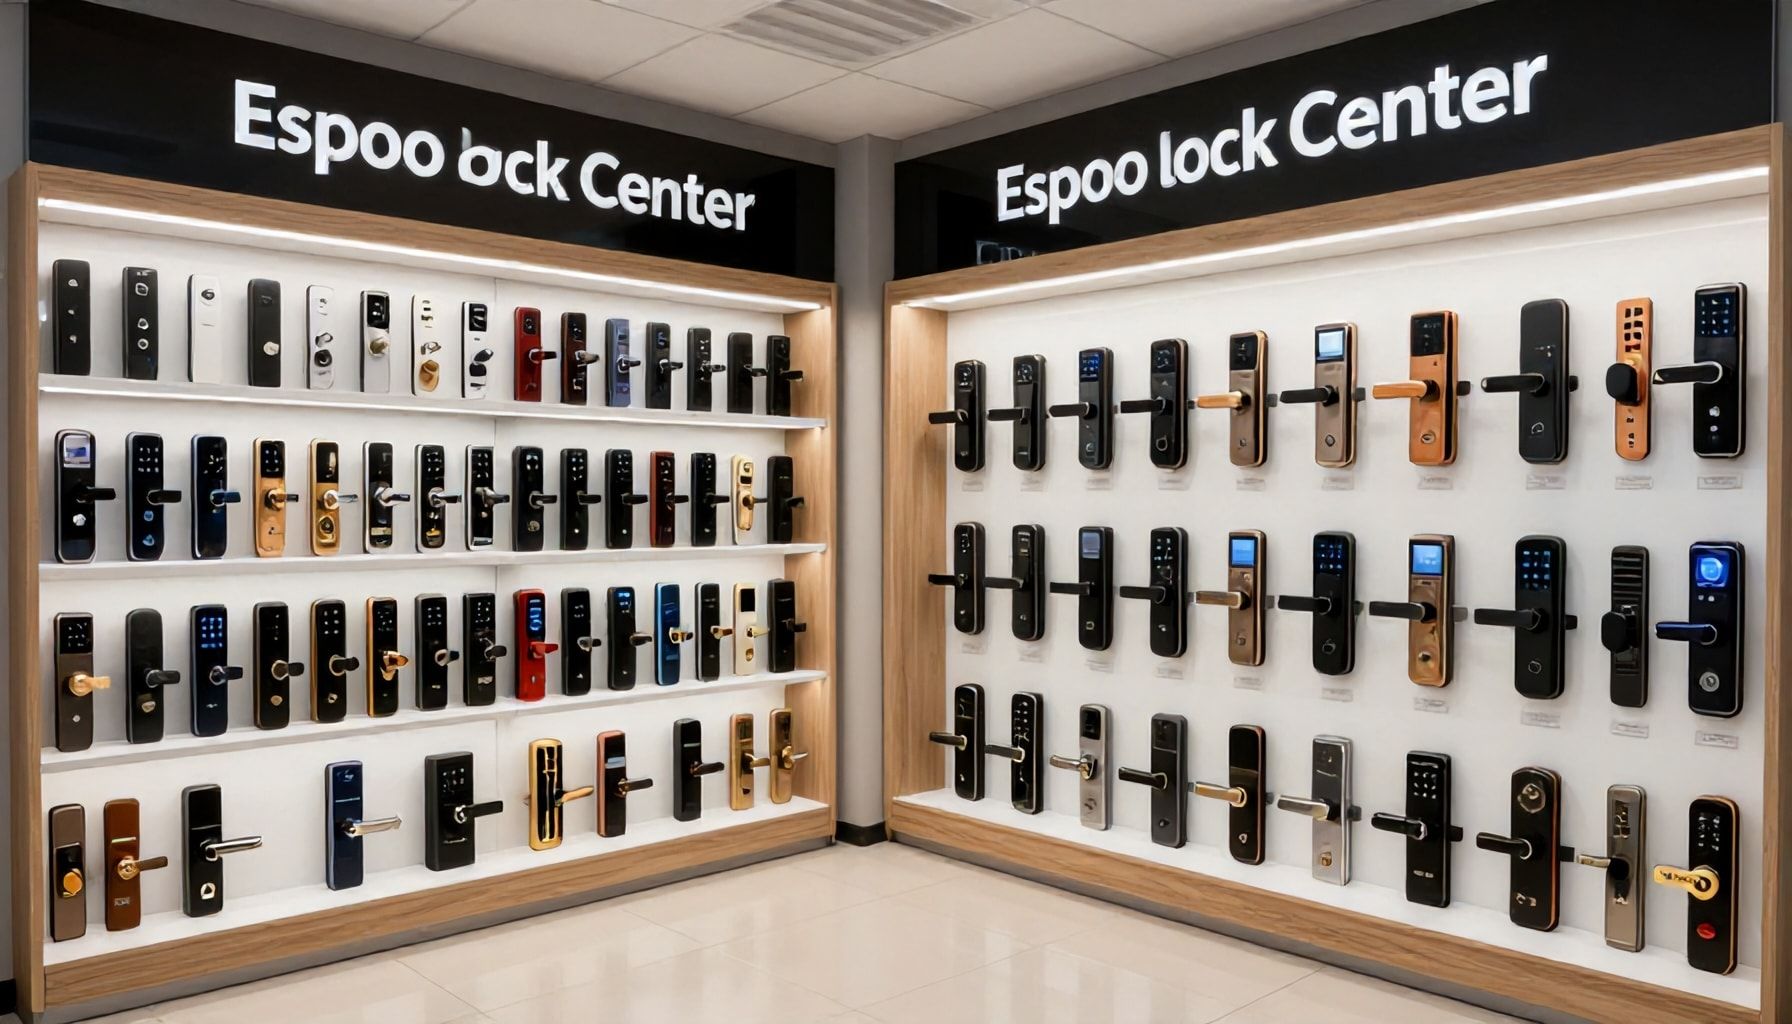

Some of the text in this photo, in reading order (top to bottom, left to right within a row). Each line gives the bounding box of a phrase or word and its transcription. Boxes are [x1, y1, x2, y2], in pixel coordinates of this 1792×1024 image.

[234, 79, 445, 176] Espoo
[580, 152, 756, 231] Center
[997, 54, 1548, 225] Espoo lock Center
